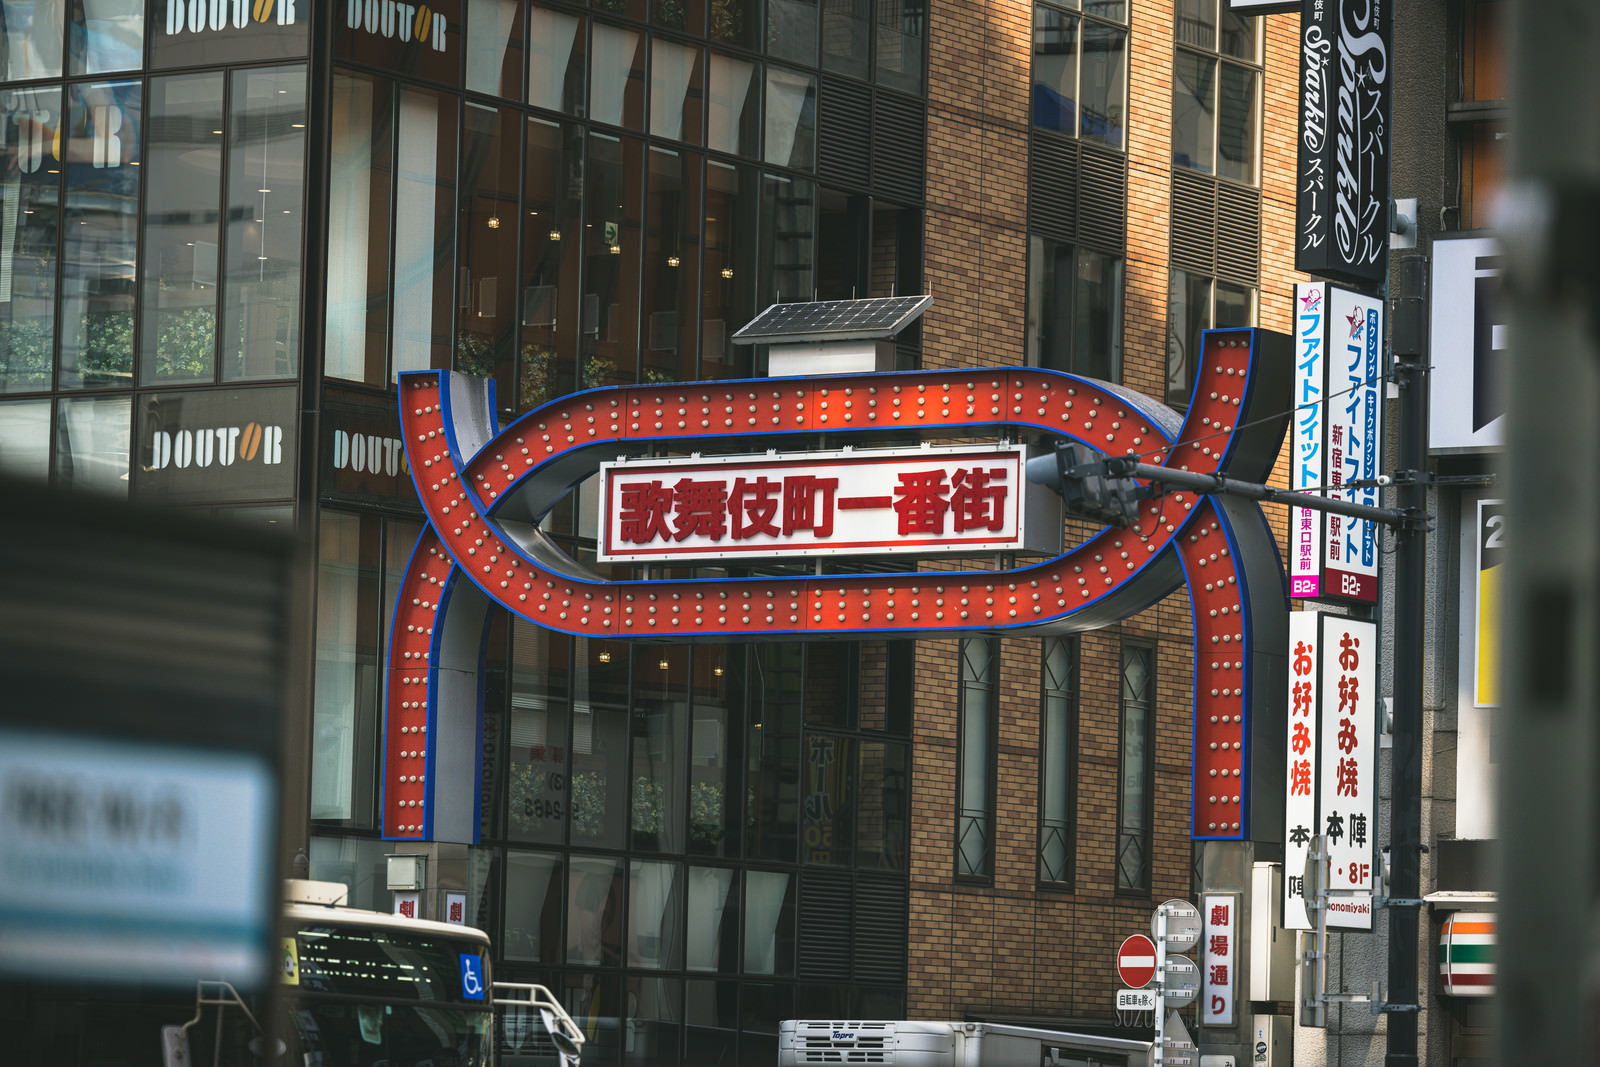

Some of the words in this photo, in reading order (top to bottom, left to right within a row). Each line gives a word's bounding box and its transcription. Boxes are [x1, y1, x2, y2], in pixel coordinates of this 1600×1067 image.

[166, 0, 296, 35] DOUTOR
[347, 0, 448, 53] DOUTOR
[1303, 25, 1331, 154] Sparkle
[1335, 0, 1387, 265] Sparkle
[1302, 159, 1326, 251] スパークル
[1357, 89, 1384, 266] スパークル
[1367, 312, 1377, 378] ボクシング
[1298, 315, 1321, 488] ファイトフィット
[153, 422, 283, 469] DOUTOR
[1365, 394, 1375, 491] キックボクシン
[619, 467, 1009, 544] 歌舞伎町一番街
[1299, 491, 1313, 571] 宿東口駅前
[1293, 580, 1317, 594] B2F
[1341, 574, 1361, 596] B2F
[1290, 640, 1314, 797] お好み焼
[1336, 632, 1360, 798] お好み焼
[1326, 810, 1368, 849] 本陣
[1327, 861, 1370, 885] ・8F
[450, 902, 463, 922] 劇
[1327, 902, 1370, 916] onomiyaki
[1209, 905, 1229, 1015] 劇場通り
[1119, 994, 1153, 1007] 自転車を除く
[832, 1030, 855, 1040] Topre
